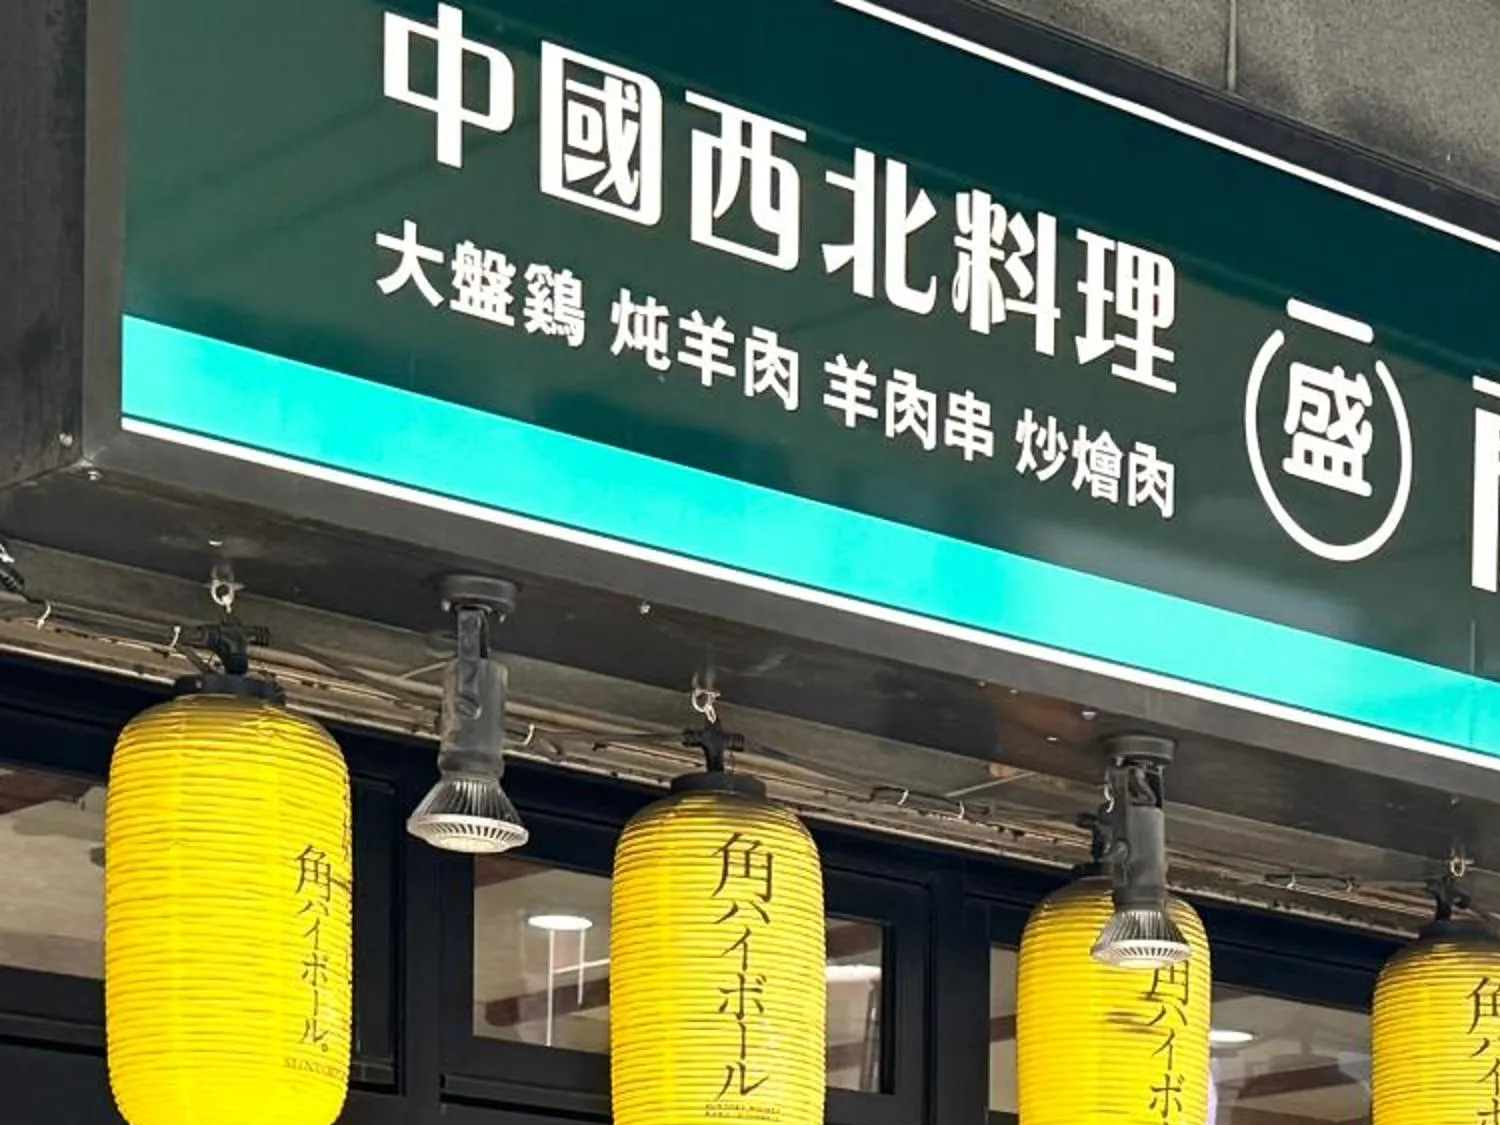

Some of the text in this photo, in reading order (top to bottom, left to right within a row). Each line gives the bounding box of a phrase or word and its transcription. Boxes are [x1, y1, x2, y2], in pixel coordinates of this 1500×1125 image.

[383, 3, 1179, 393] 中國西北料理
[609, 287, 799, 411] 炖羊肉
[823, 353, 994, 462] 羊肉串
[1015, 408, 1175, 518] 炒燴肉
[712, 831, 774, 1101] 角ハイボール
